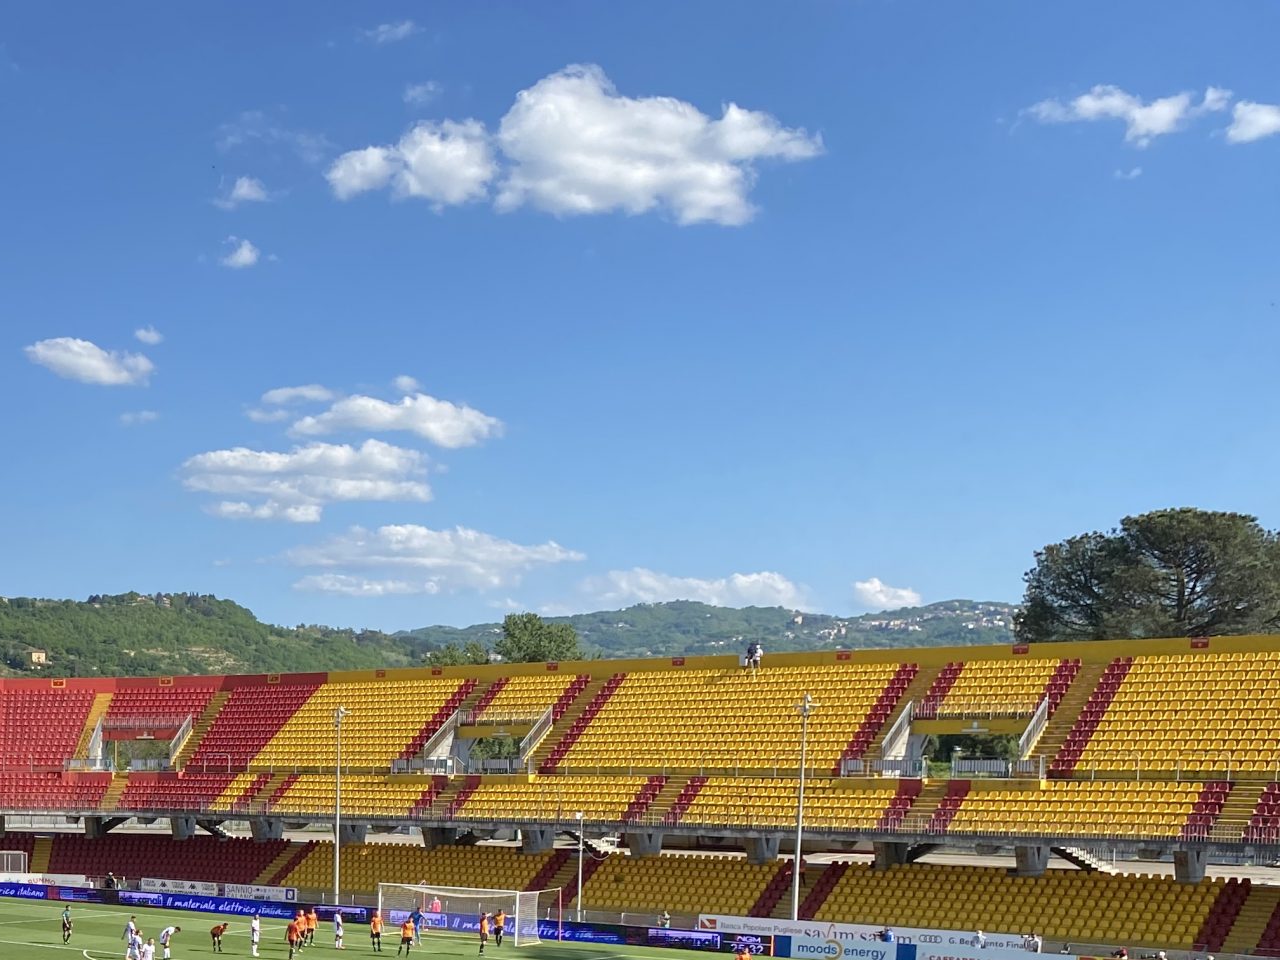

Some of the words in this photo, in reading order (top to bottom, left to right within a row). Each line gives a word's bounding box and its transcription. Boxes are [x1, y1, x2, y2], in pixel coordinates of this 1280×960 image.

[17, 885, 45, 897] italiano
[226, 885, 253, 894] SANNIO
[174, 898, 216, 911] materiale
[219, 900, 256, 914] elettrico
[736, 935, 761, 944] NGM
[797, 943, 838, 956] moods
[843, 947, 887, 960] energy
